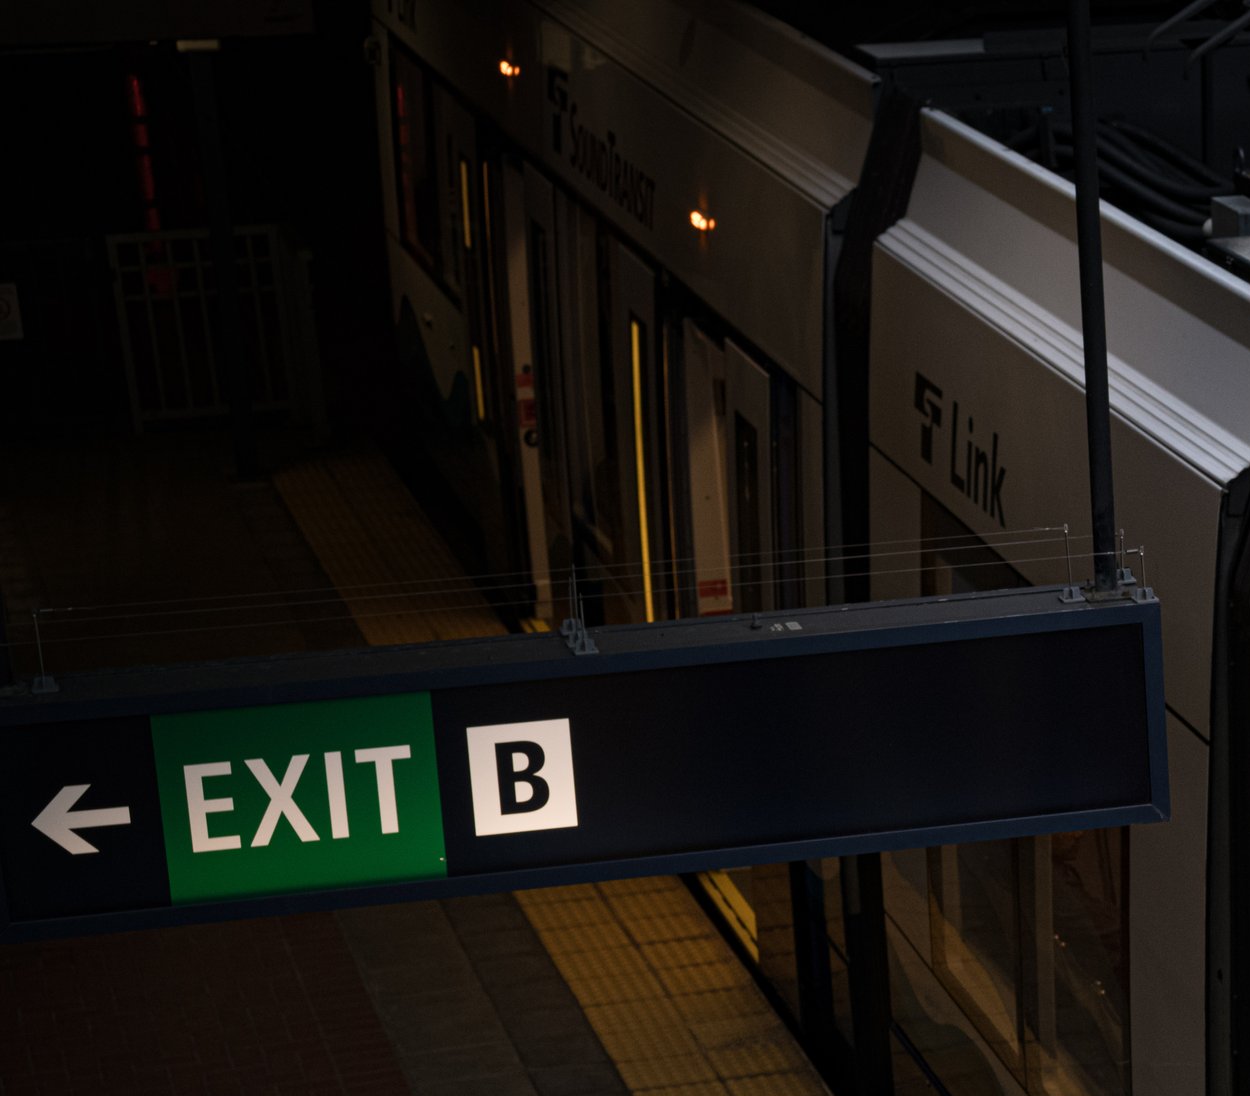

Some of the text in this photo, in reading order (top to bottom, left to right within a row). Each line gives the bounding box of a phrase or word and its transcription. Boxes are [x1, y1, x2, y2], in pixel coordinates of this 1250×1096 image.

[951, 401, 1005, 529] Link
[182, 740, 550, 854] EXIT B
